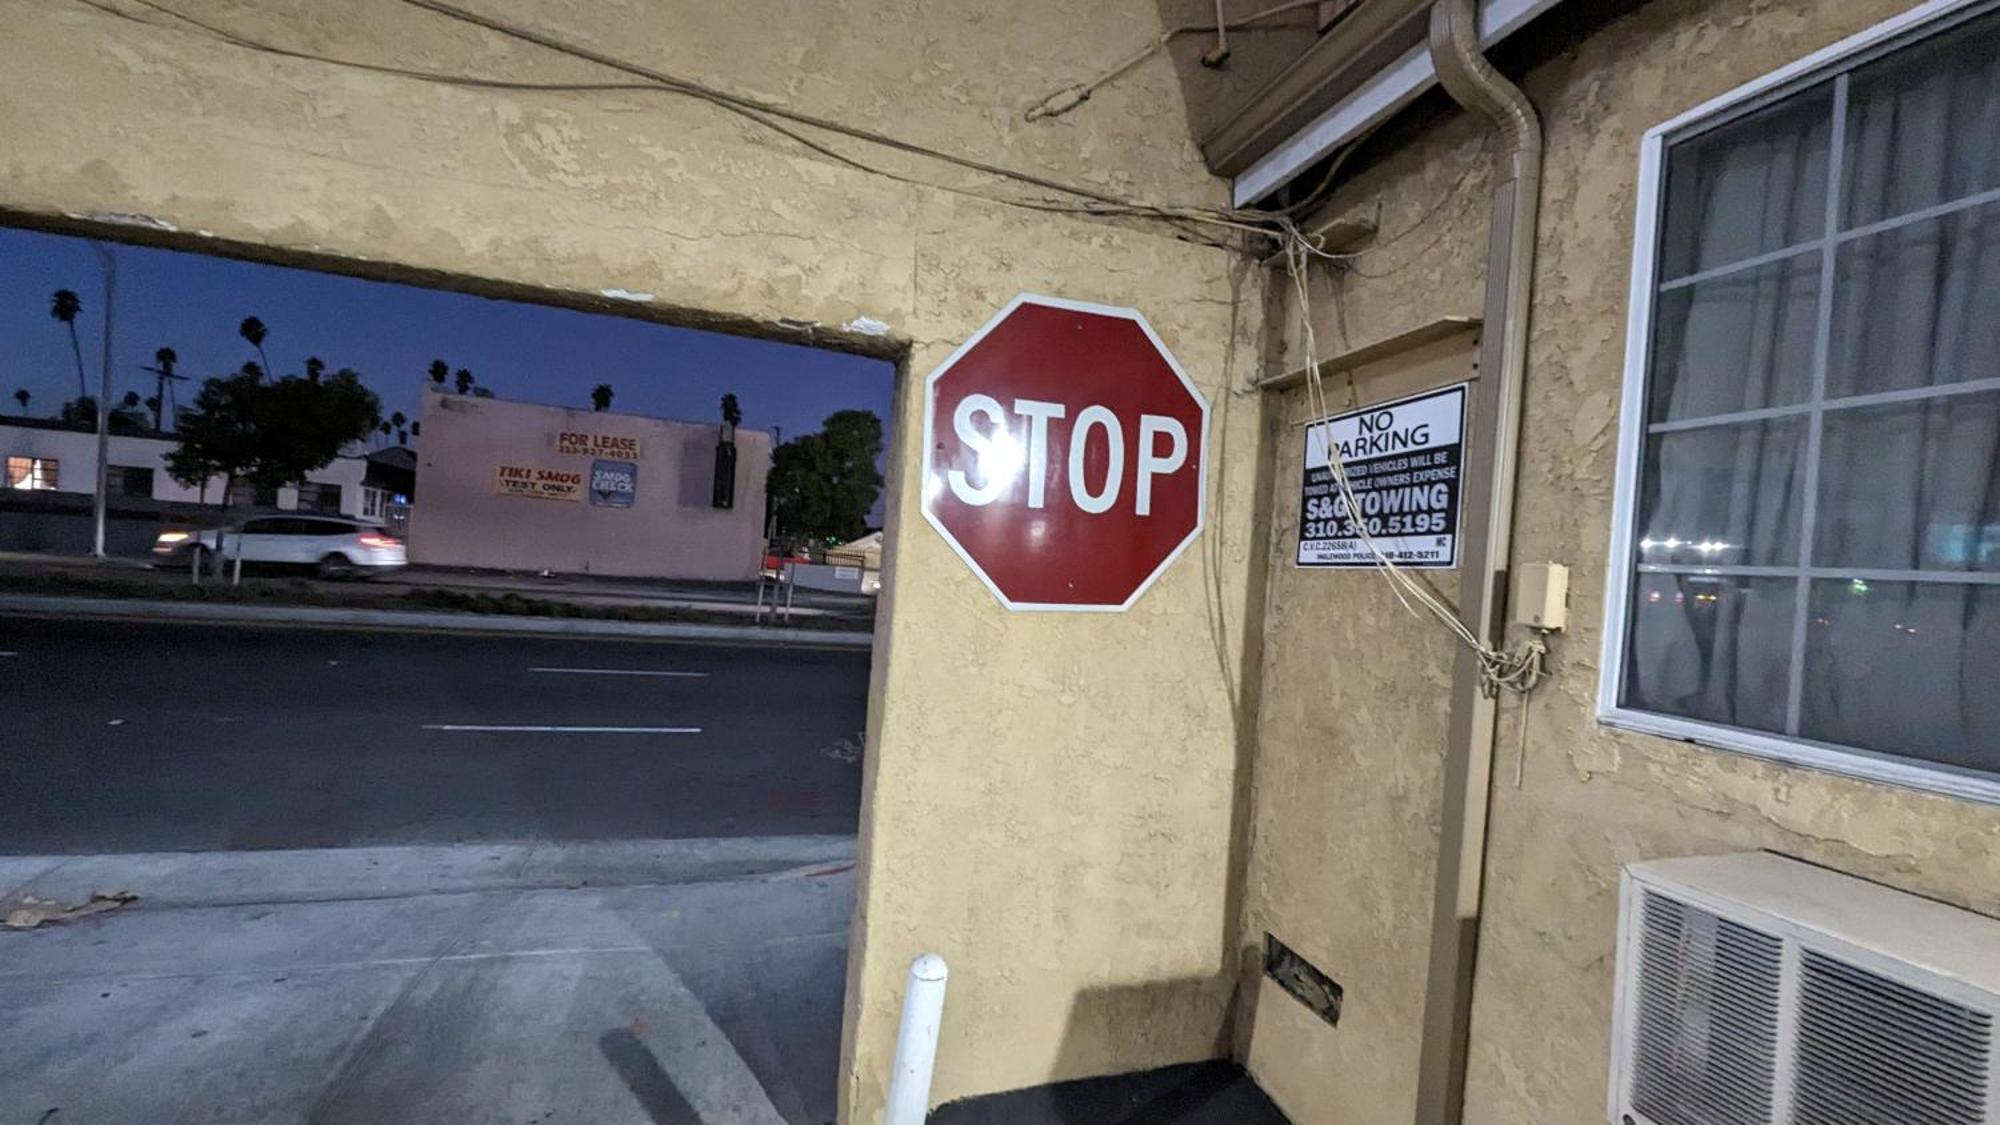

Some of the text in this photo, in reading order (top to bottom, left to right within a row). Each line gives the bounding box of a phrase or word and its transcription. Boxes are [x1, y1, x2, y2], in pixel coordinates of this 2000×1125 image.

[1358, 411, 1394, 436] NO
[560, 432, 637, 451] FOR LEASE
[947, 393, 1189, 516] STOP
[1410, 453, 1432, 468] WILL
[1433, 451, 1448, 465] BE
[499, 466, 582, 485] TIKI SMOG
[594, 470, 631, 483] SMOG
[1412, 465, 1457, 483] EXPENSE
[503, 479, 536, 489] TEST
[592, 479, 633, 492] CHECK
[1306, 483, 1449, 520] S&G TOWING
